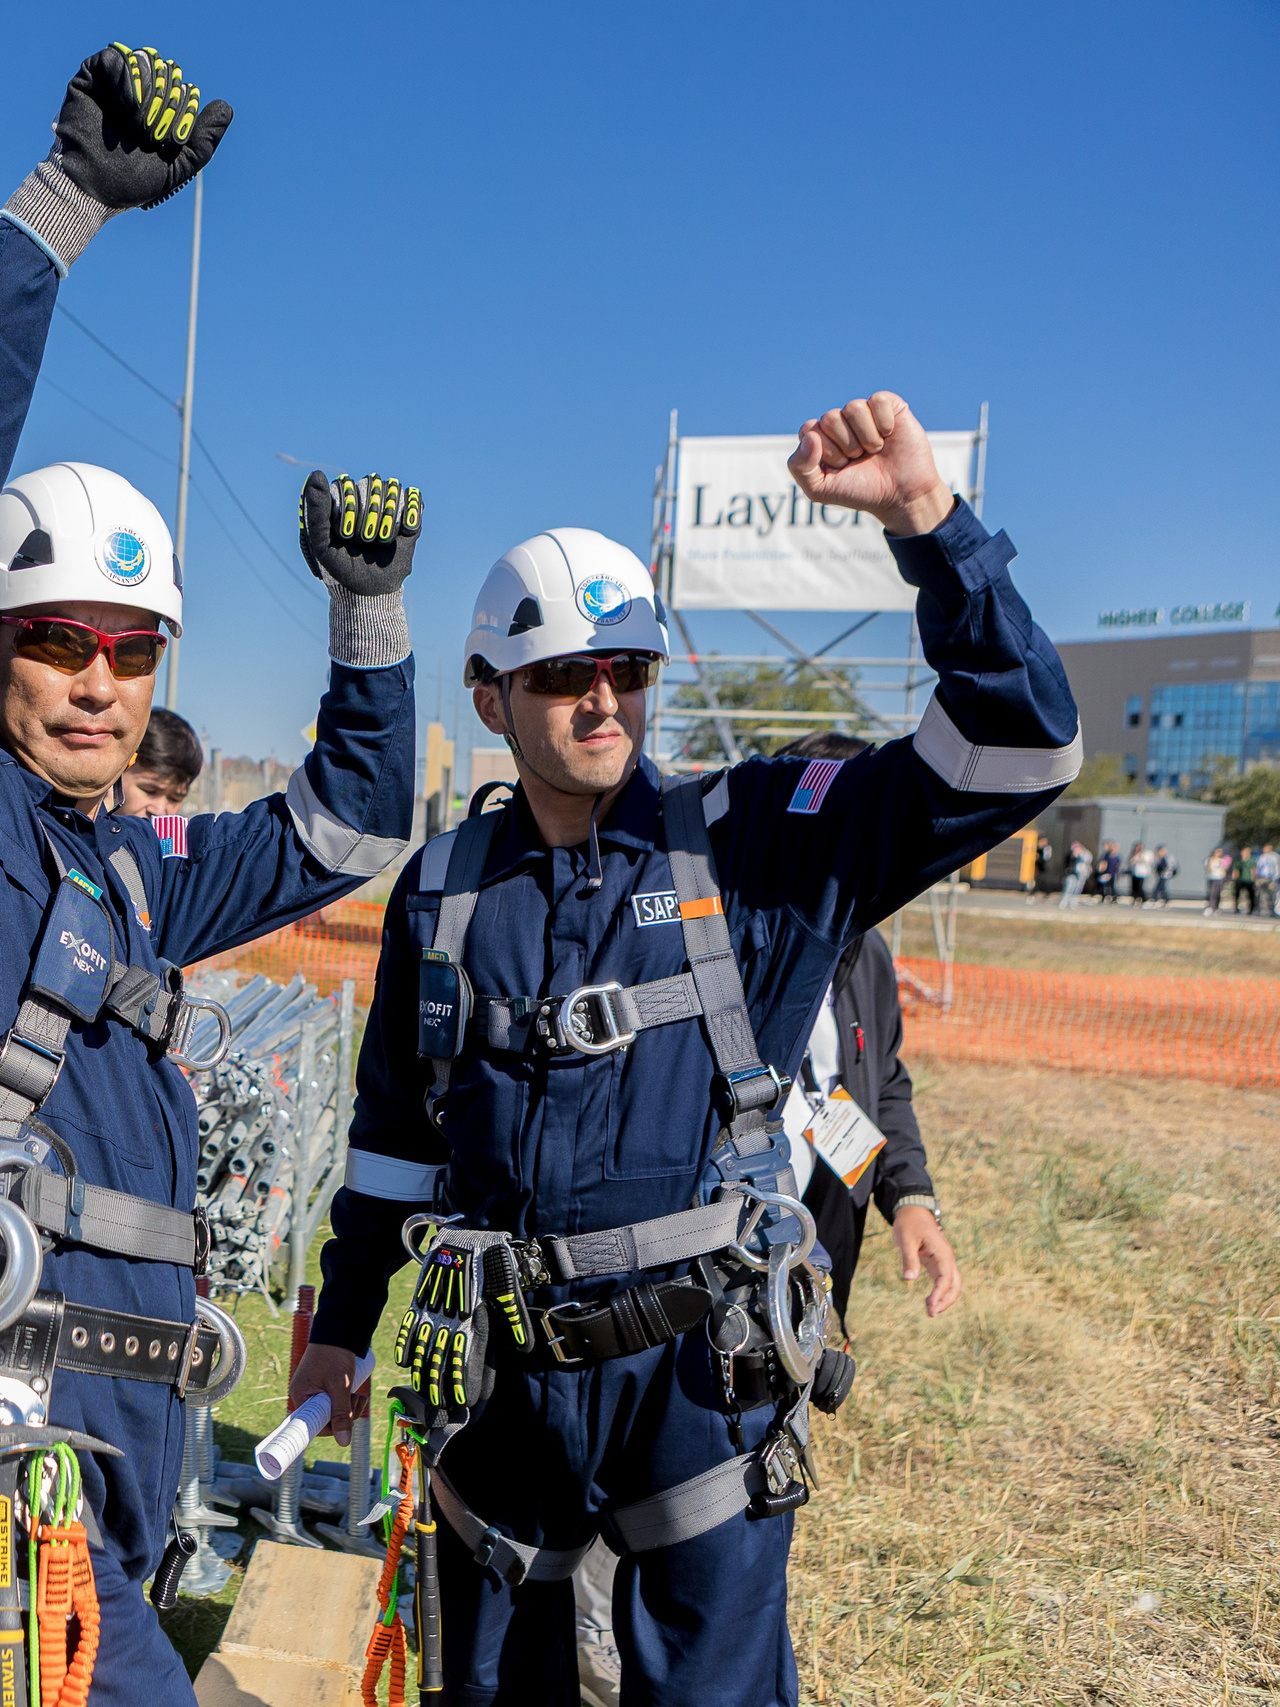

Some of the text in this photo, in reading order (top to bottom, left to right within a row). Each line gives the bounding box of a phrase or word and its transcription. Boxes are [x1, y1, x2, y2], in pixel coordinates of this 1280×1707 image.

[641, 895, 680, 922] SAP
[59, 930, 107, 972] EXOFIT
[420, 999, 453, 1017] EXOFIT
[0, 1525, 9, 1583] STRIKE
